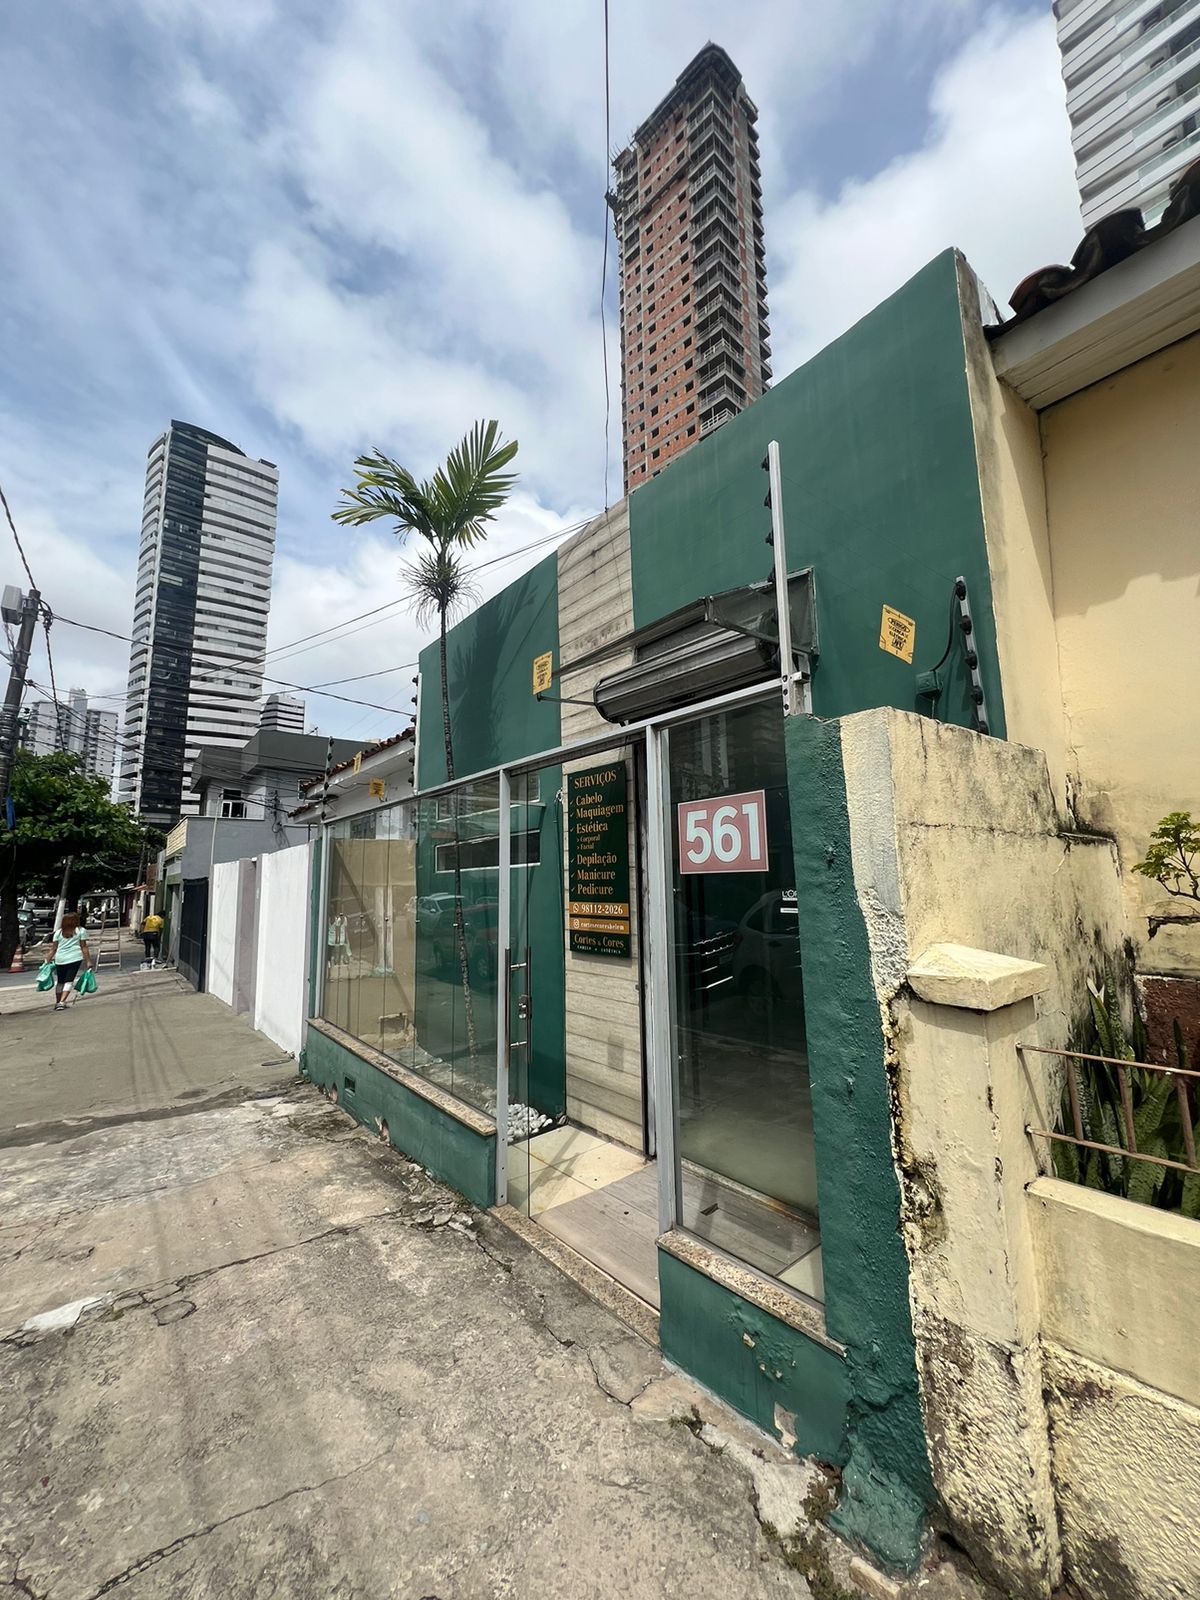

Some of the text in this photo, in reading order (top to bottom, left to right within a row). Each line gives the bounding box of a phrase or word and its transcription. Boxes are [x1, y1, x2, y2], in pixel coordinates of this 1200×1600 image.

[574, 770, 617, 788] SERVIÇOS
[576, 792, 603, 806] Cabelo
[576, 804, 624, 819] Maquiagem
[576, 820, 609, 834] Estética
[686, 802, 760, 864] 561
[577, 852, 617, 867] Depilação
[577, 868, 616, 881] Manicure
[577, 883, 614, 895] Pedicure
[581, 903, 623, 915] 98112-2026
[574, 933, 597, 945] Cortes
[602, 936, 625, 949] Cores
